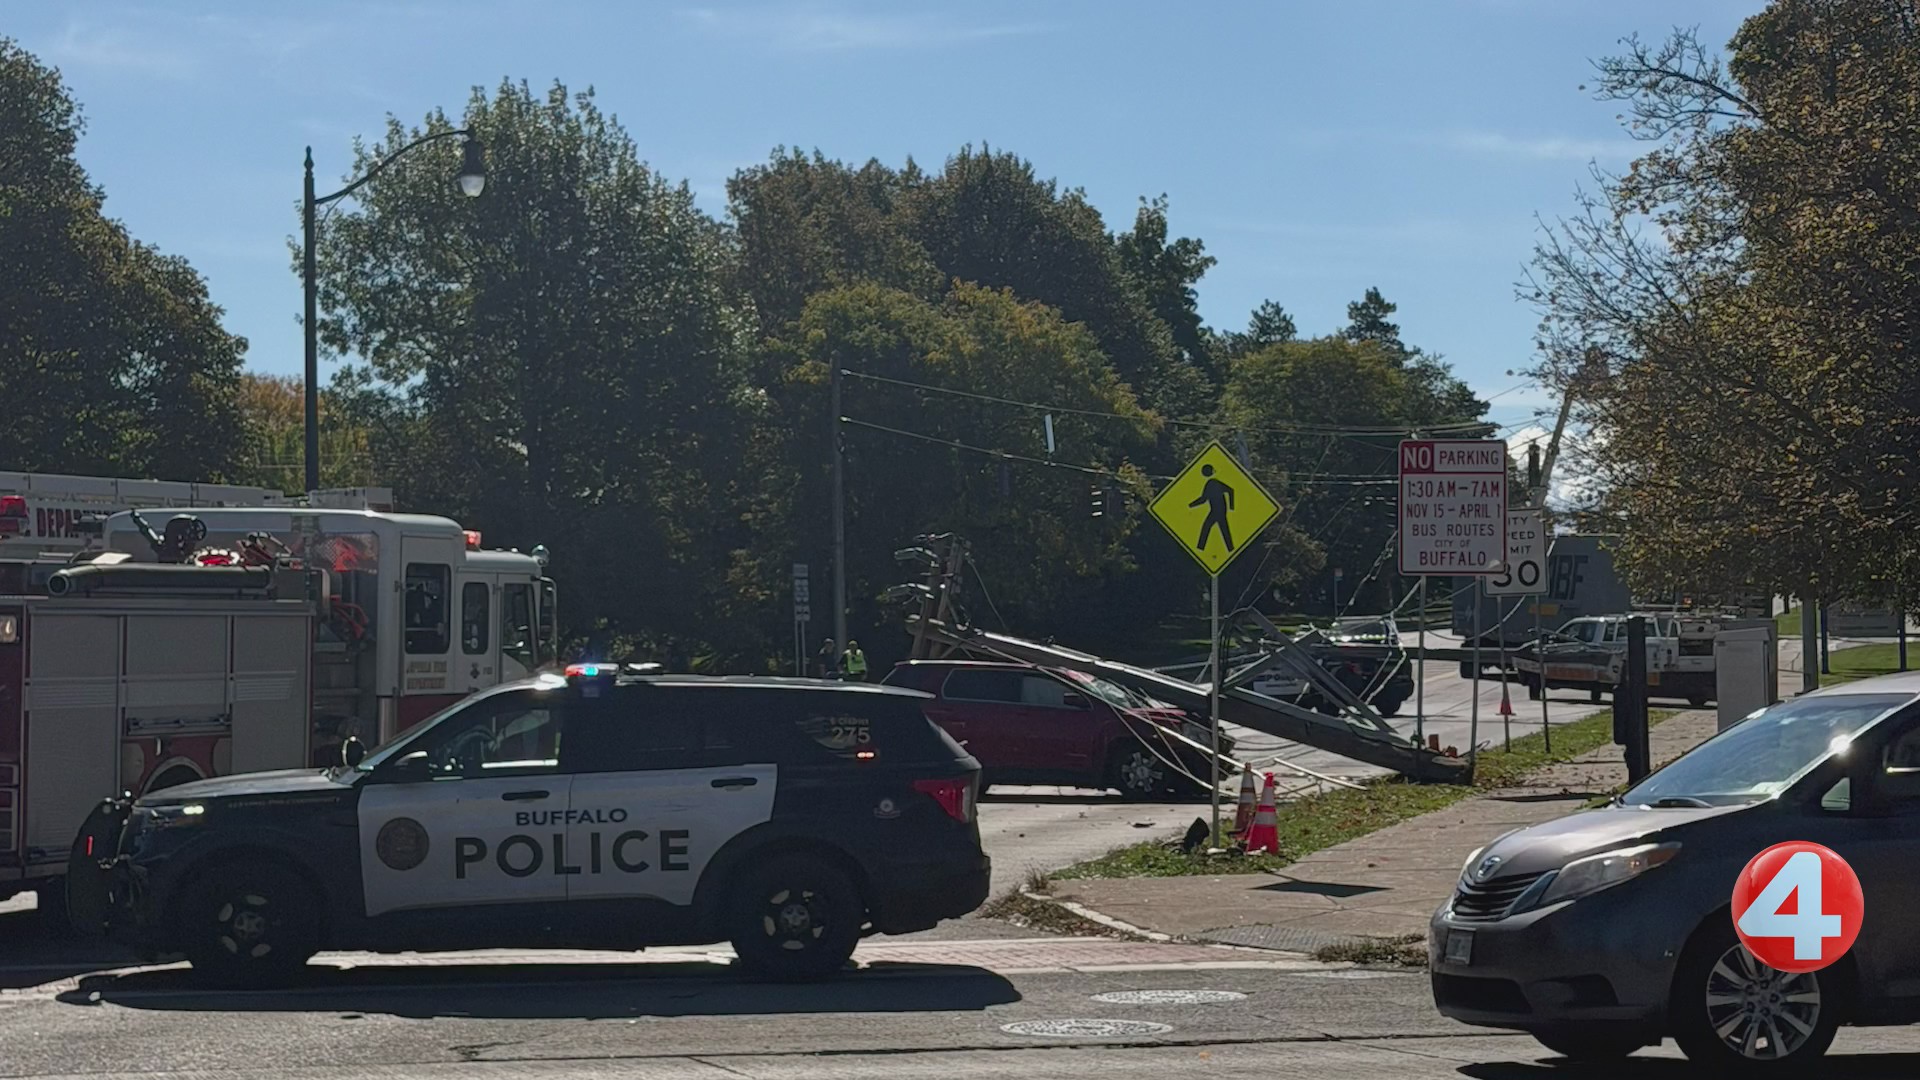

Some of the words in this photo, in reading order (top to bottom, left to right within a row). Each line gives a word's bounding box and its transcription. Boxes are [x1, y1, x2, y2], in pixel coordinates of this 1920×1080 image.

[1403, 446, 1432, 470] NO
[1439, 450, 1500, 465] PARKING
[1407, 480, 1433, 498] 1:30
[1436, 480, 1456, 498] AM
[1471, 480, 1500, 498] 7AM
[1406, 504, 1428, 518] NOV
[1433, 504, 1445, 518] 15
[1459, 504, 1490, 518] APRIL
[1497, 504, 1501, 518] 1
[1508, 516, 1528, 525] ITY
[1412, 524, 1437, 537] BUS
[1447, 524, 1495, 537] ROUTES
[1507, 531, 1535, 540] EED
[1434, 539, 1454, 548] CITY
[1459, 539, 1471, 548] OF
[1510, 545, 1531, 555] MIT
[1419, 551, 1486, 566] BUFFALO
[1492, 560, 1540, 588] 30
[831, 726, 871, 744] 275
[515, 808, 628, 826] BUFFALO
[455, 829, 690, 879] POLICE
